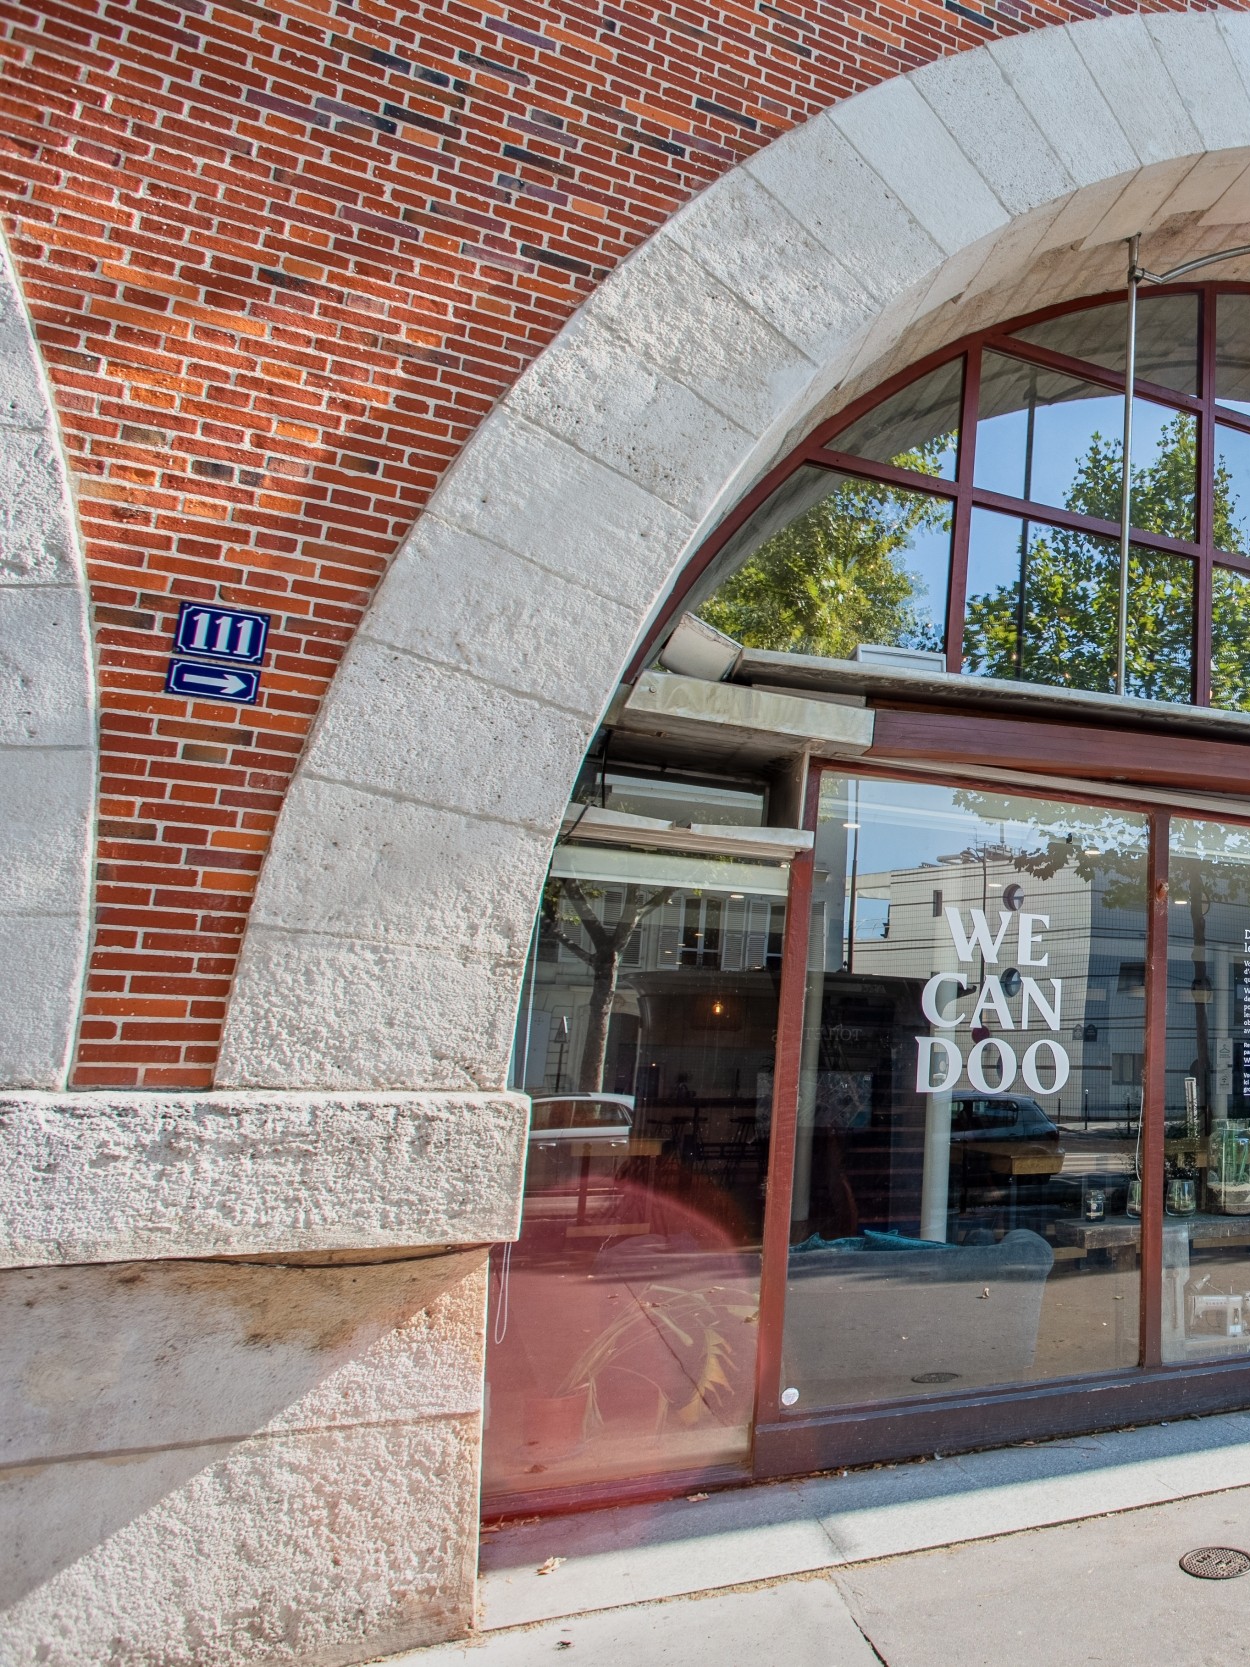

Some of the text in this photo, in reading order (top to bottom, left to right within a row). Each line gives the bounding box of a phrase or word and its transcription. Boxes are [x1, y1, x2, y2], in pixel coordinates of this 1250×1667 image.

[190, 612, 253, 655] 111
[944, 907, 1050, 967] WE
[922, 973, 1062, 1031] CAN
[915, 1036, 1069, 1094] DOO
